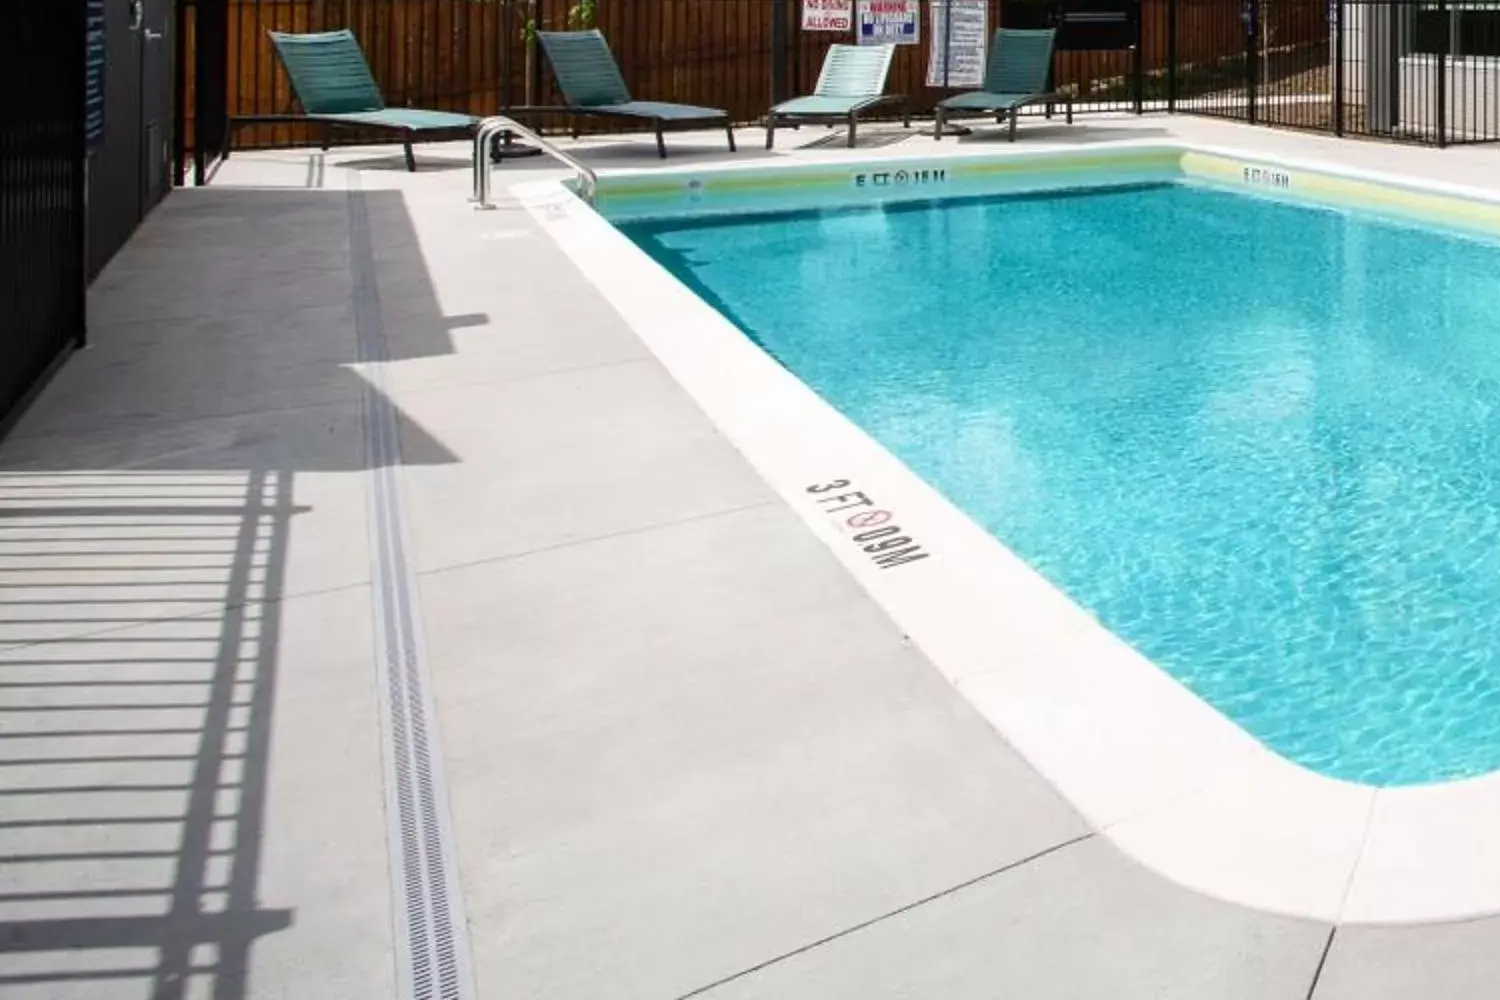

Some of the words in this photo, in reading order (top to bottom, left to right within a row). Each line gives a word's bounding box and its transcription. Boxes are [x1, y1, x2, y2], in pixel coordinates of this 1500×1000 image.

[806, 16, 848, 29] ALLOWED
[806, 478, 851, 494] 3
[816, 491, 874, 513] FT
